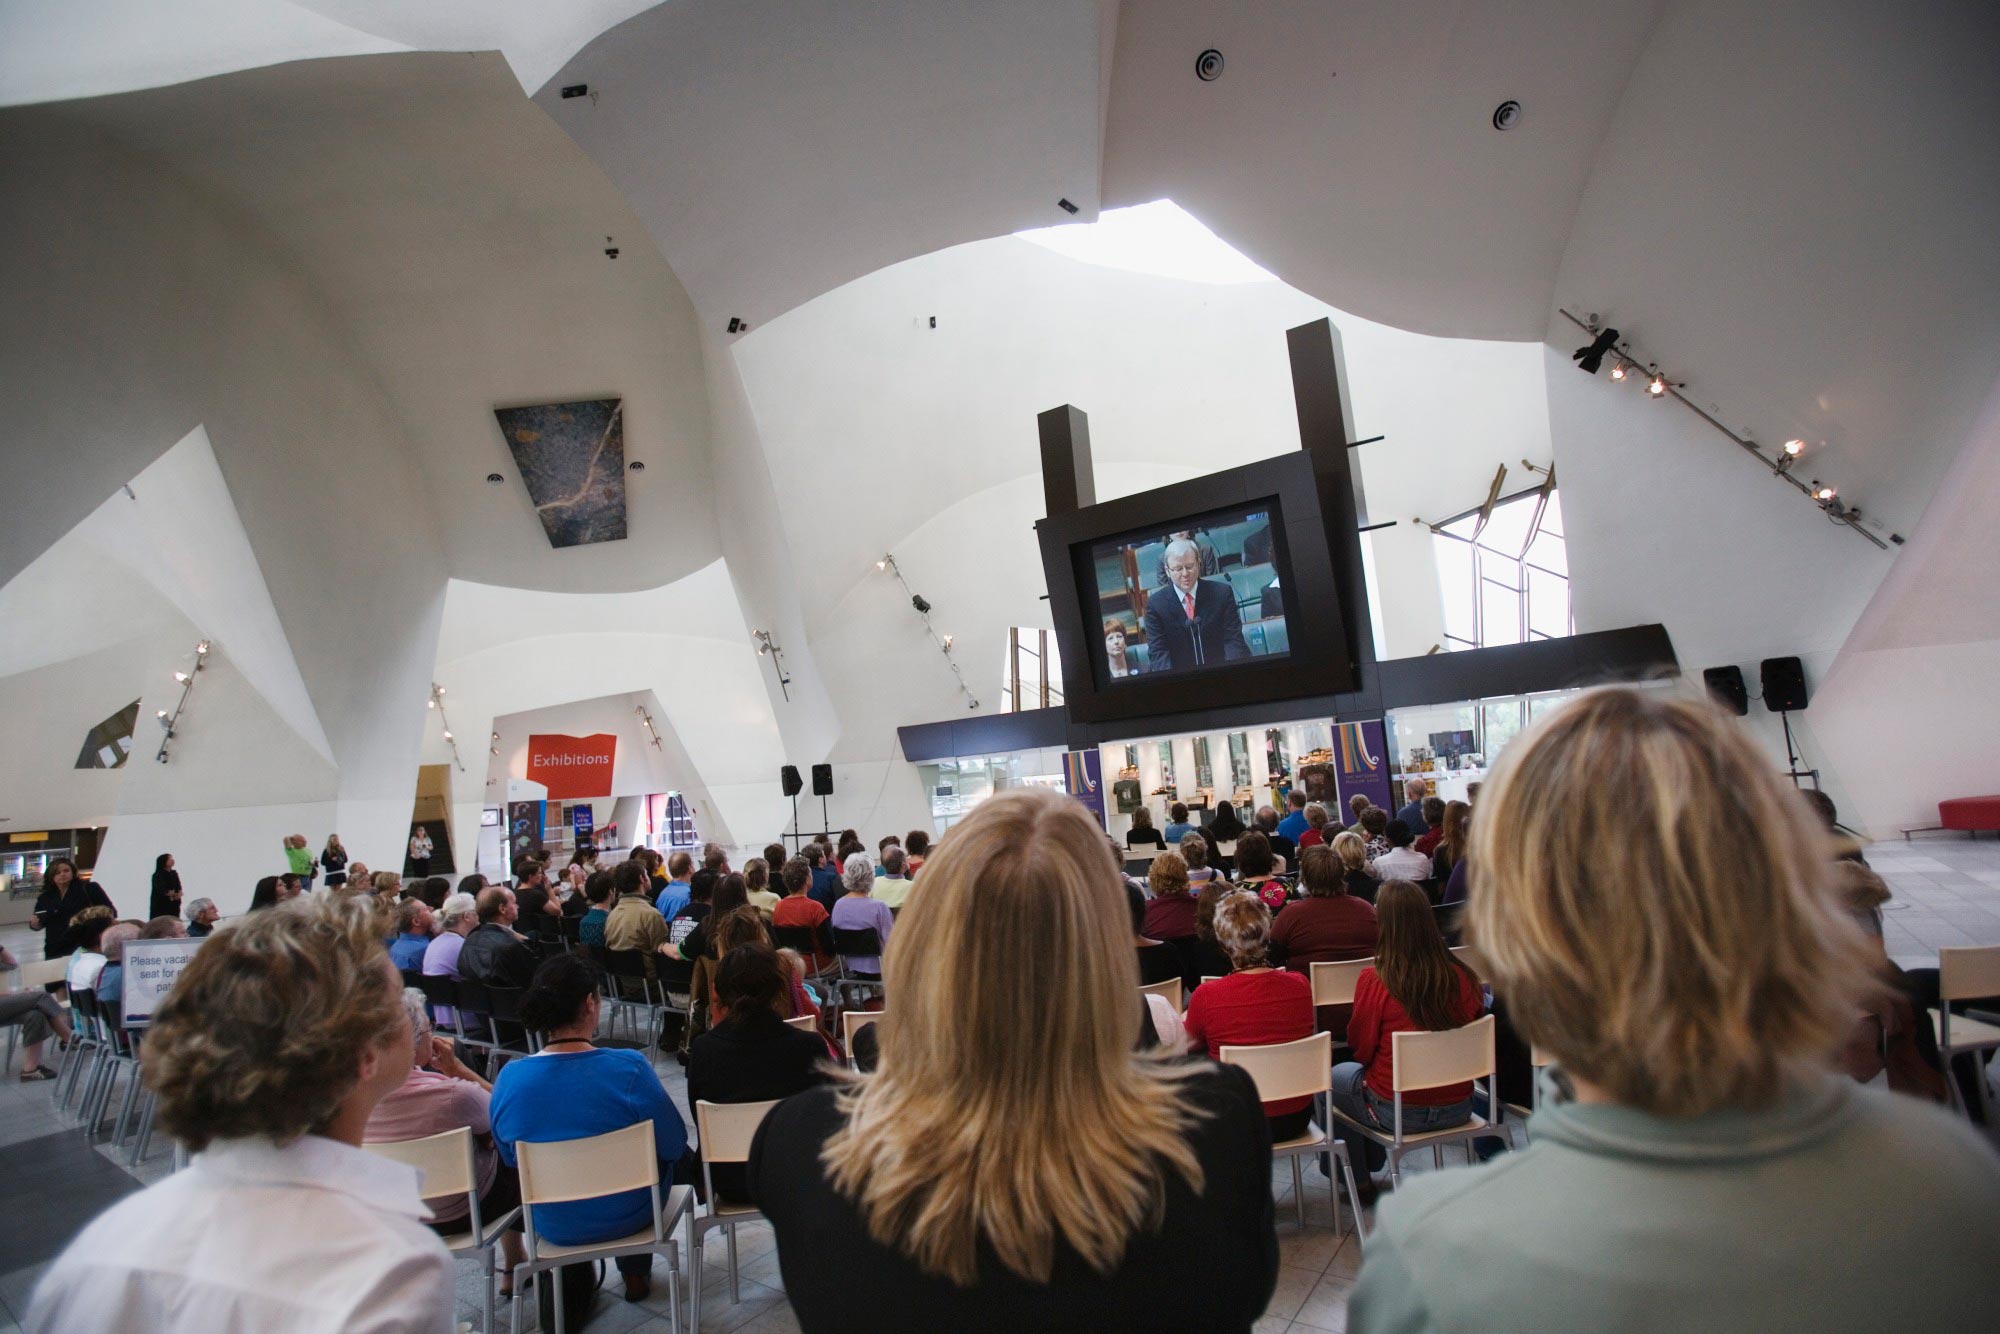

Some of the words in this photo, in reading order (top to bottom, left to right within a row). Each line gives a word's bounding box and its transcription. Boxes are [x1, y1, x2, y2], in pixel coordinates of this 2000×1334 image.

[533, 753, 609, 767] Exhibitions
[130, 956, 162, 966] Please
[140, 970, 160, 979] seat
[162, 968, 174, 978] for
